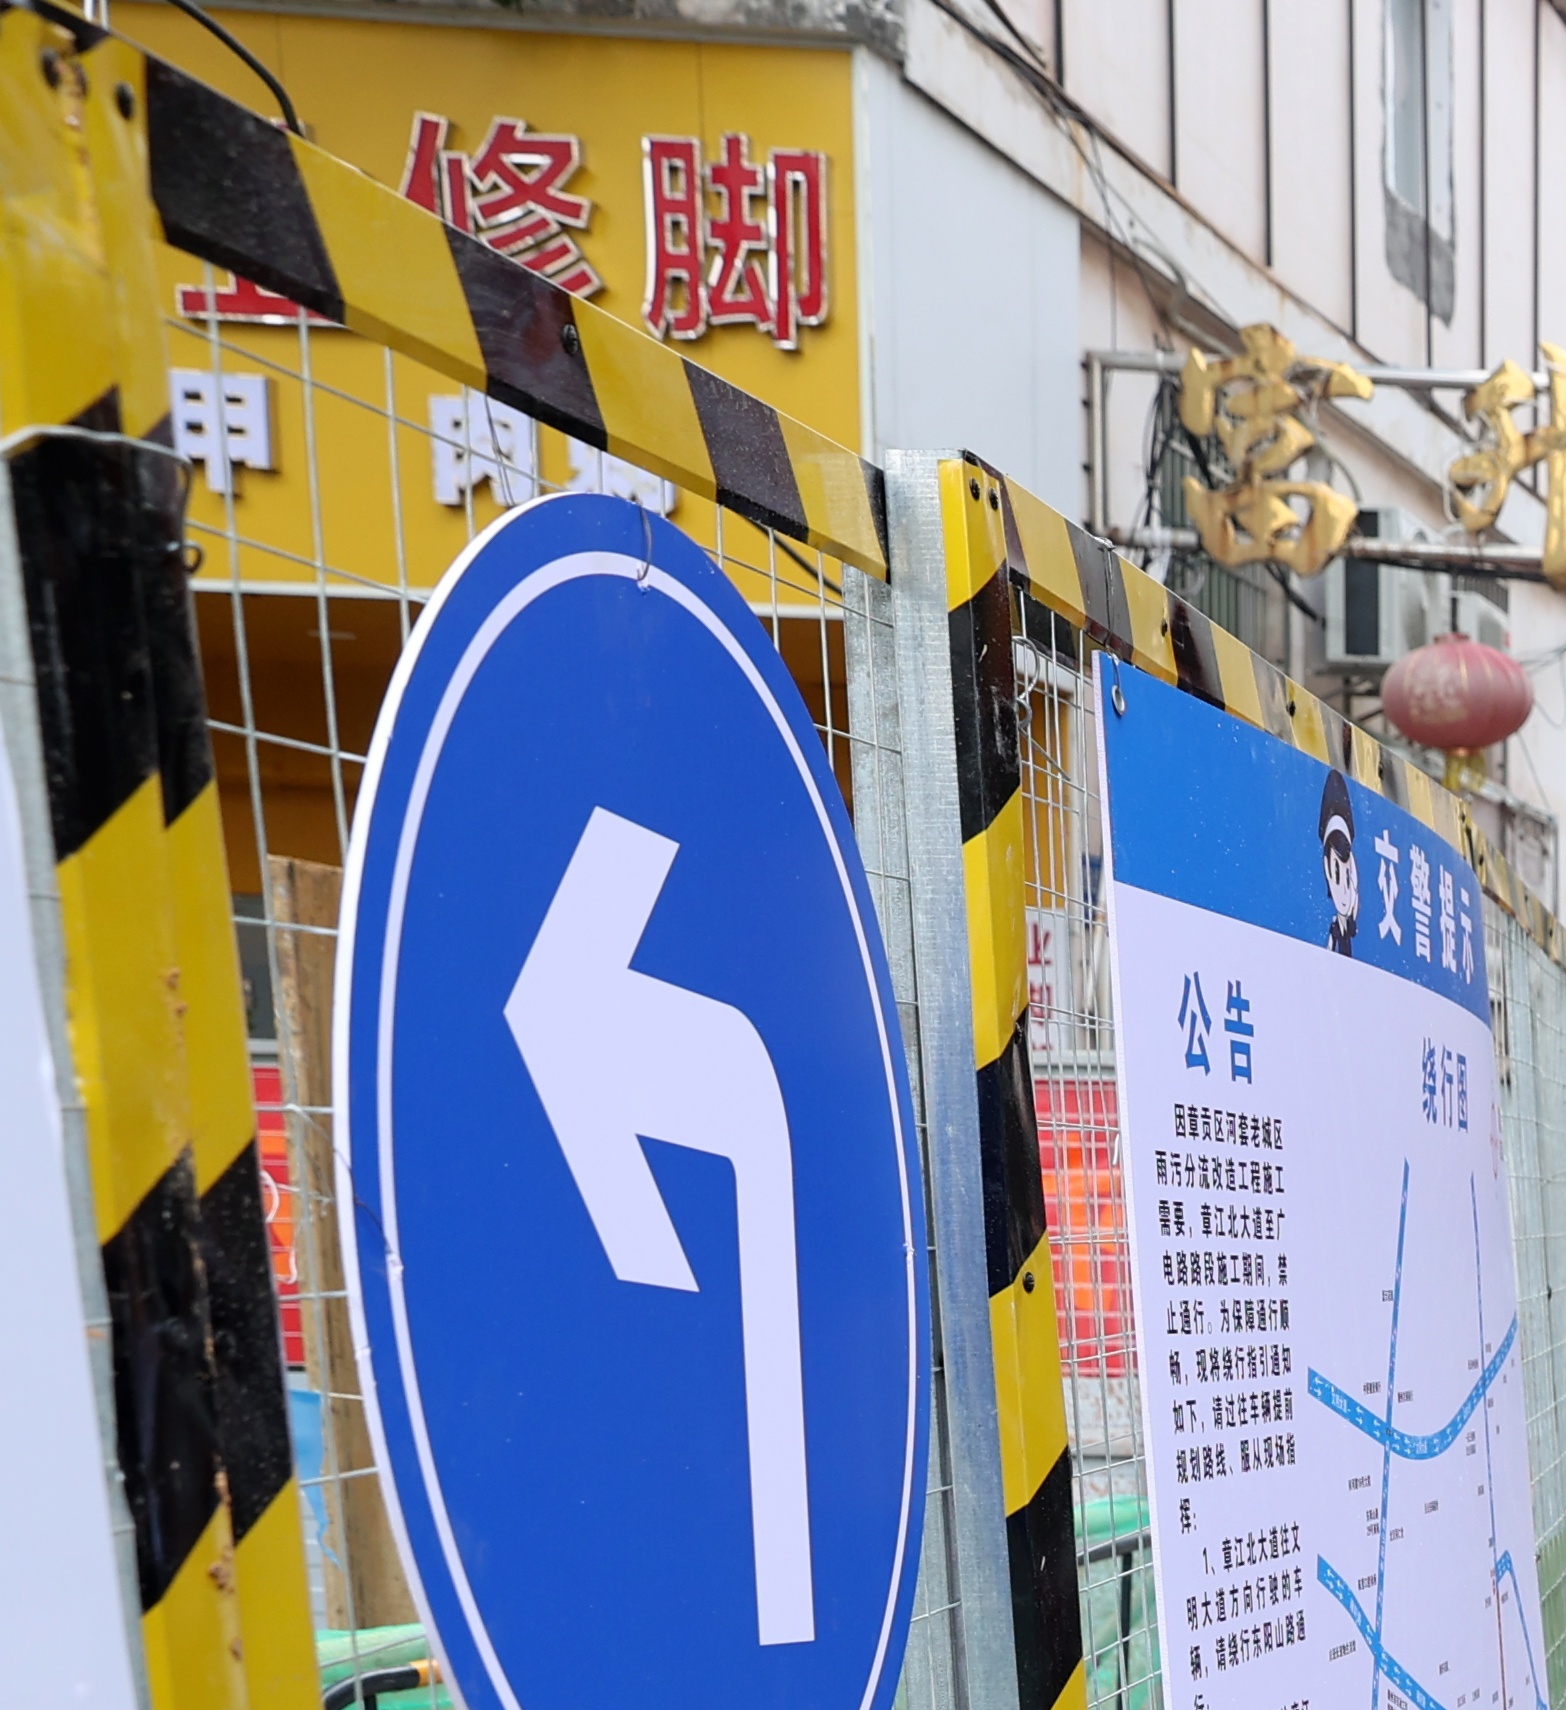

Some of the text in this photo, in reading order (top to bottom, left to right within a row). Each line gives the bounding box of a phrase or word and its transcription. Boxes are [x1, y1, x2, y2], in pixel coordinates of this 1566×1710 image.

[175, 110, 832, 352] 修脚
[1373, 828, 1476, 986] 交警提示
[1177, 971, 1255, 1086] 公告
[1174, 1103, 1284, 1150] 因章贡区河套老城区
[1421, 1036, 1469, 1134] 绕行图
[1154, 1150, 1285, 1195] 雨污分流改造工程施工
[1186, 1565, 1304, 1632] 明大道方向行驶的车
